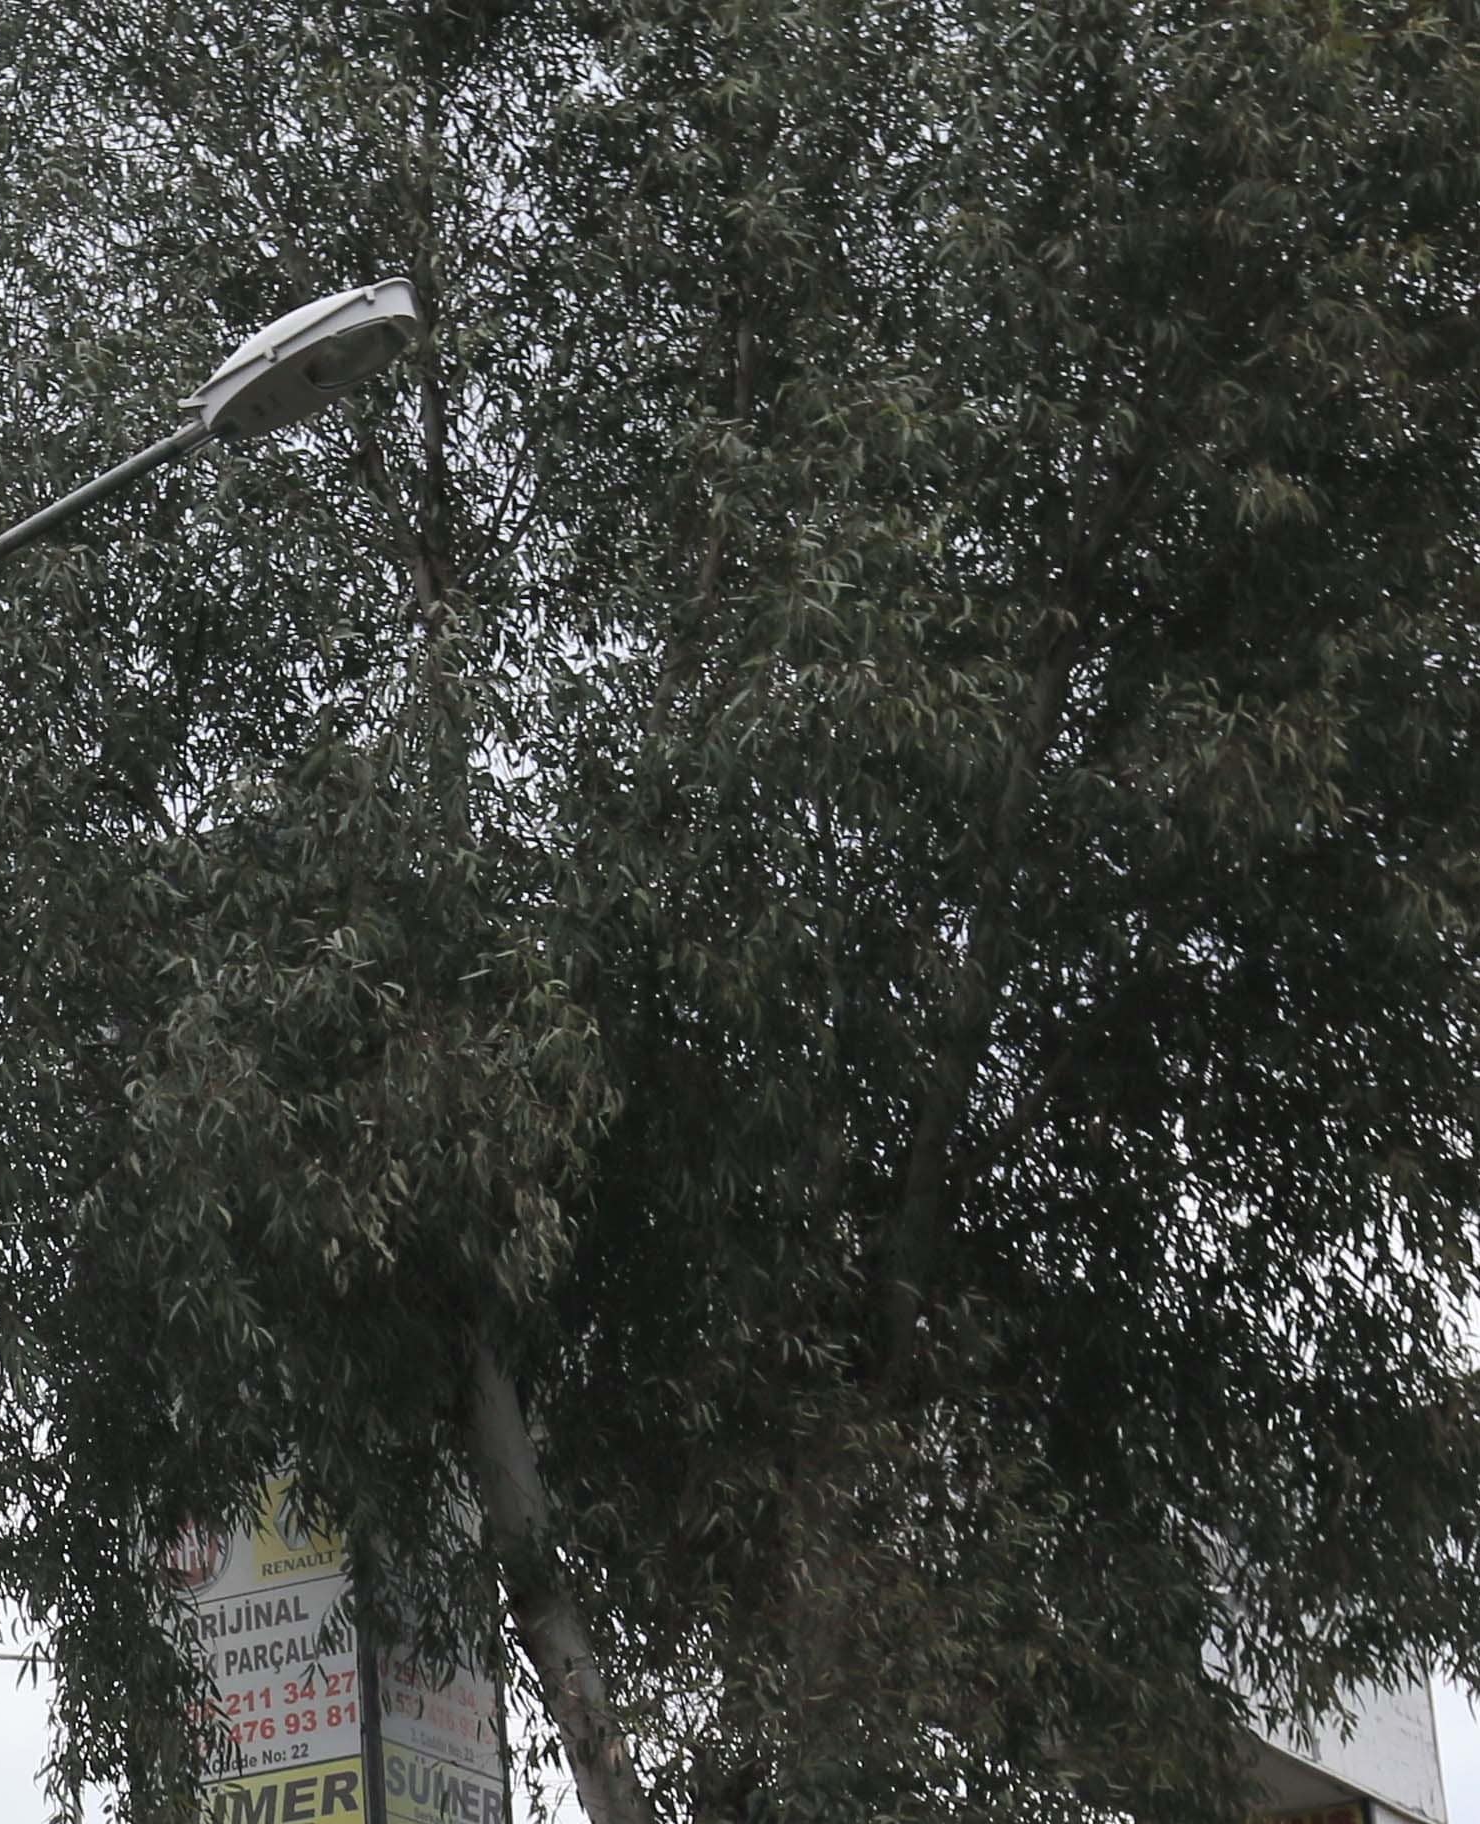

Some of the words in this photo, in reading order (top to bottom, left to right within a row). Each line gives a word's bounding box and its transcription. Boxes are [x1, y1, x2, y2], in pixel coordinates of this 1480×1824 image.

[262, 1551, 334, 1576] RENAULT
[226, 1626, 353, 1674] PARÇALARI
[226, 1688, 271, 1715] 211
[284, 1680, 316, 1705] 34
[326, 1671, 356, 1697] 27
[228, 1718, 276, 1744] 476
[285, 1710, 317, 1735] 93
[327, 1702, 356, 1727] 81
[291, 1743, 309, 1760] 22
